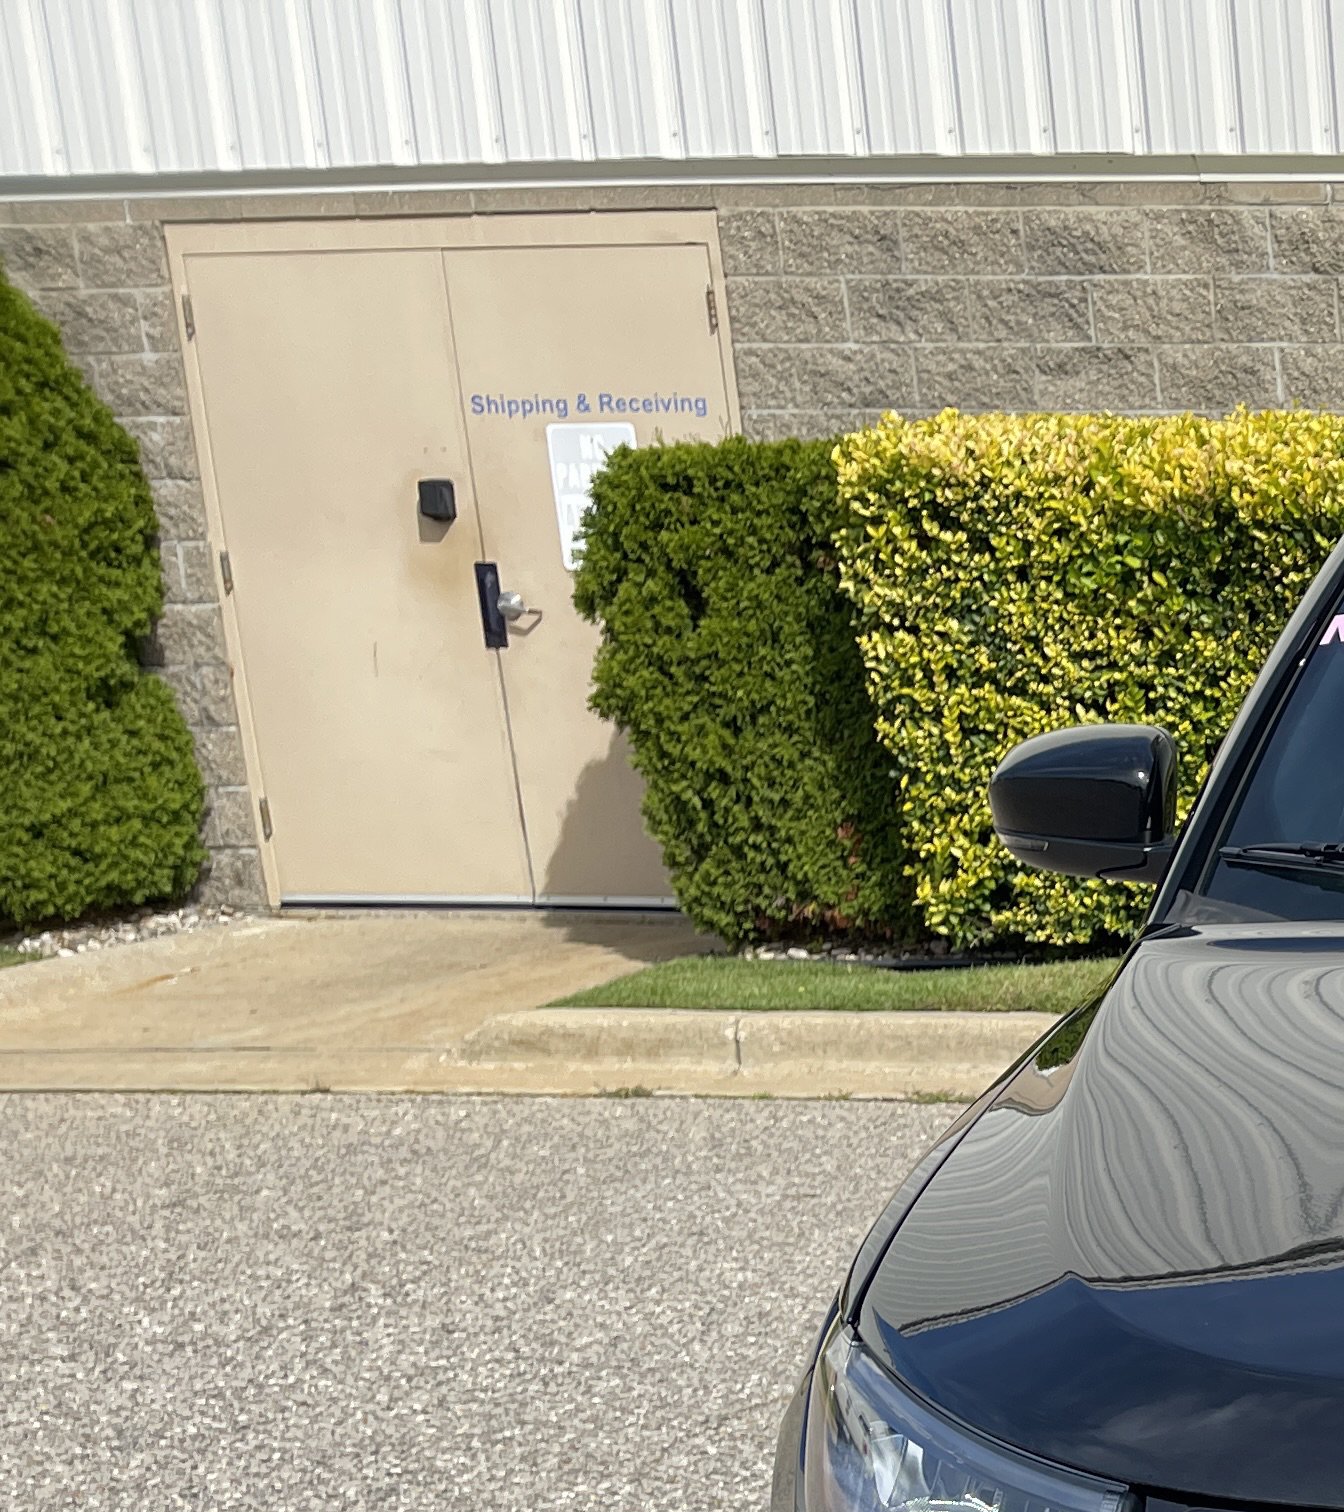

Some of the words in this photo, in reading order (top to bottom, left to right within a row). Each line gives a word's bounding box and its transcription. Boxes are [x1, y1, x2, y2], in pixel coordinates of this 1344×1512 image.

[471, 393, 568, 419] Shipping
[575, 393, 591, 413] &
[598, 392, 708, 418] Receiving
